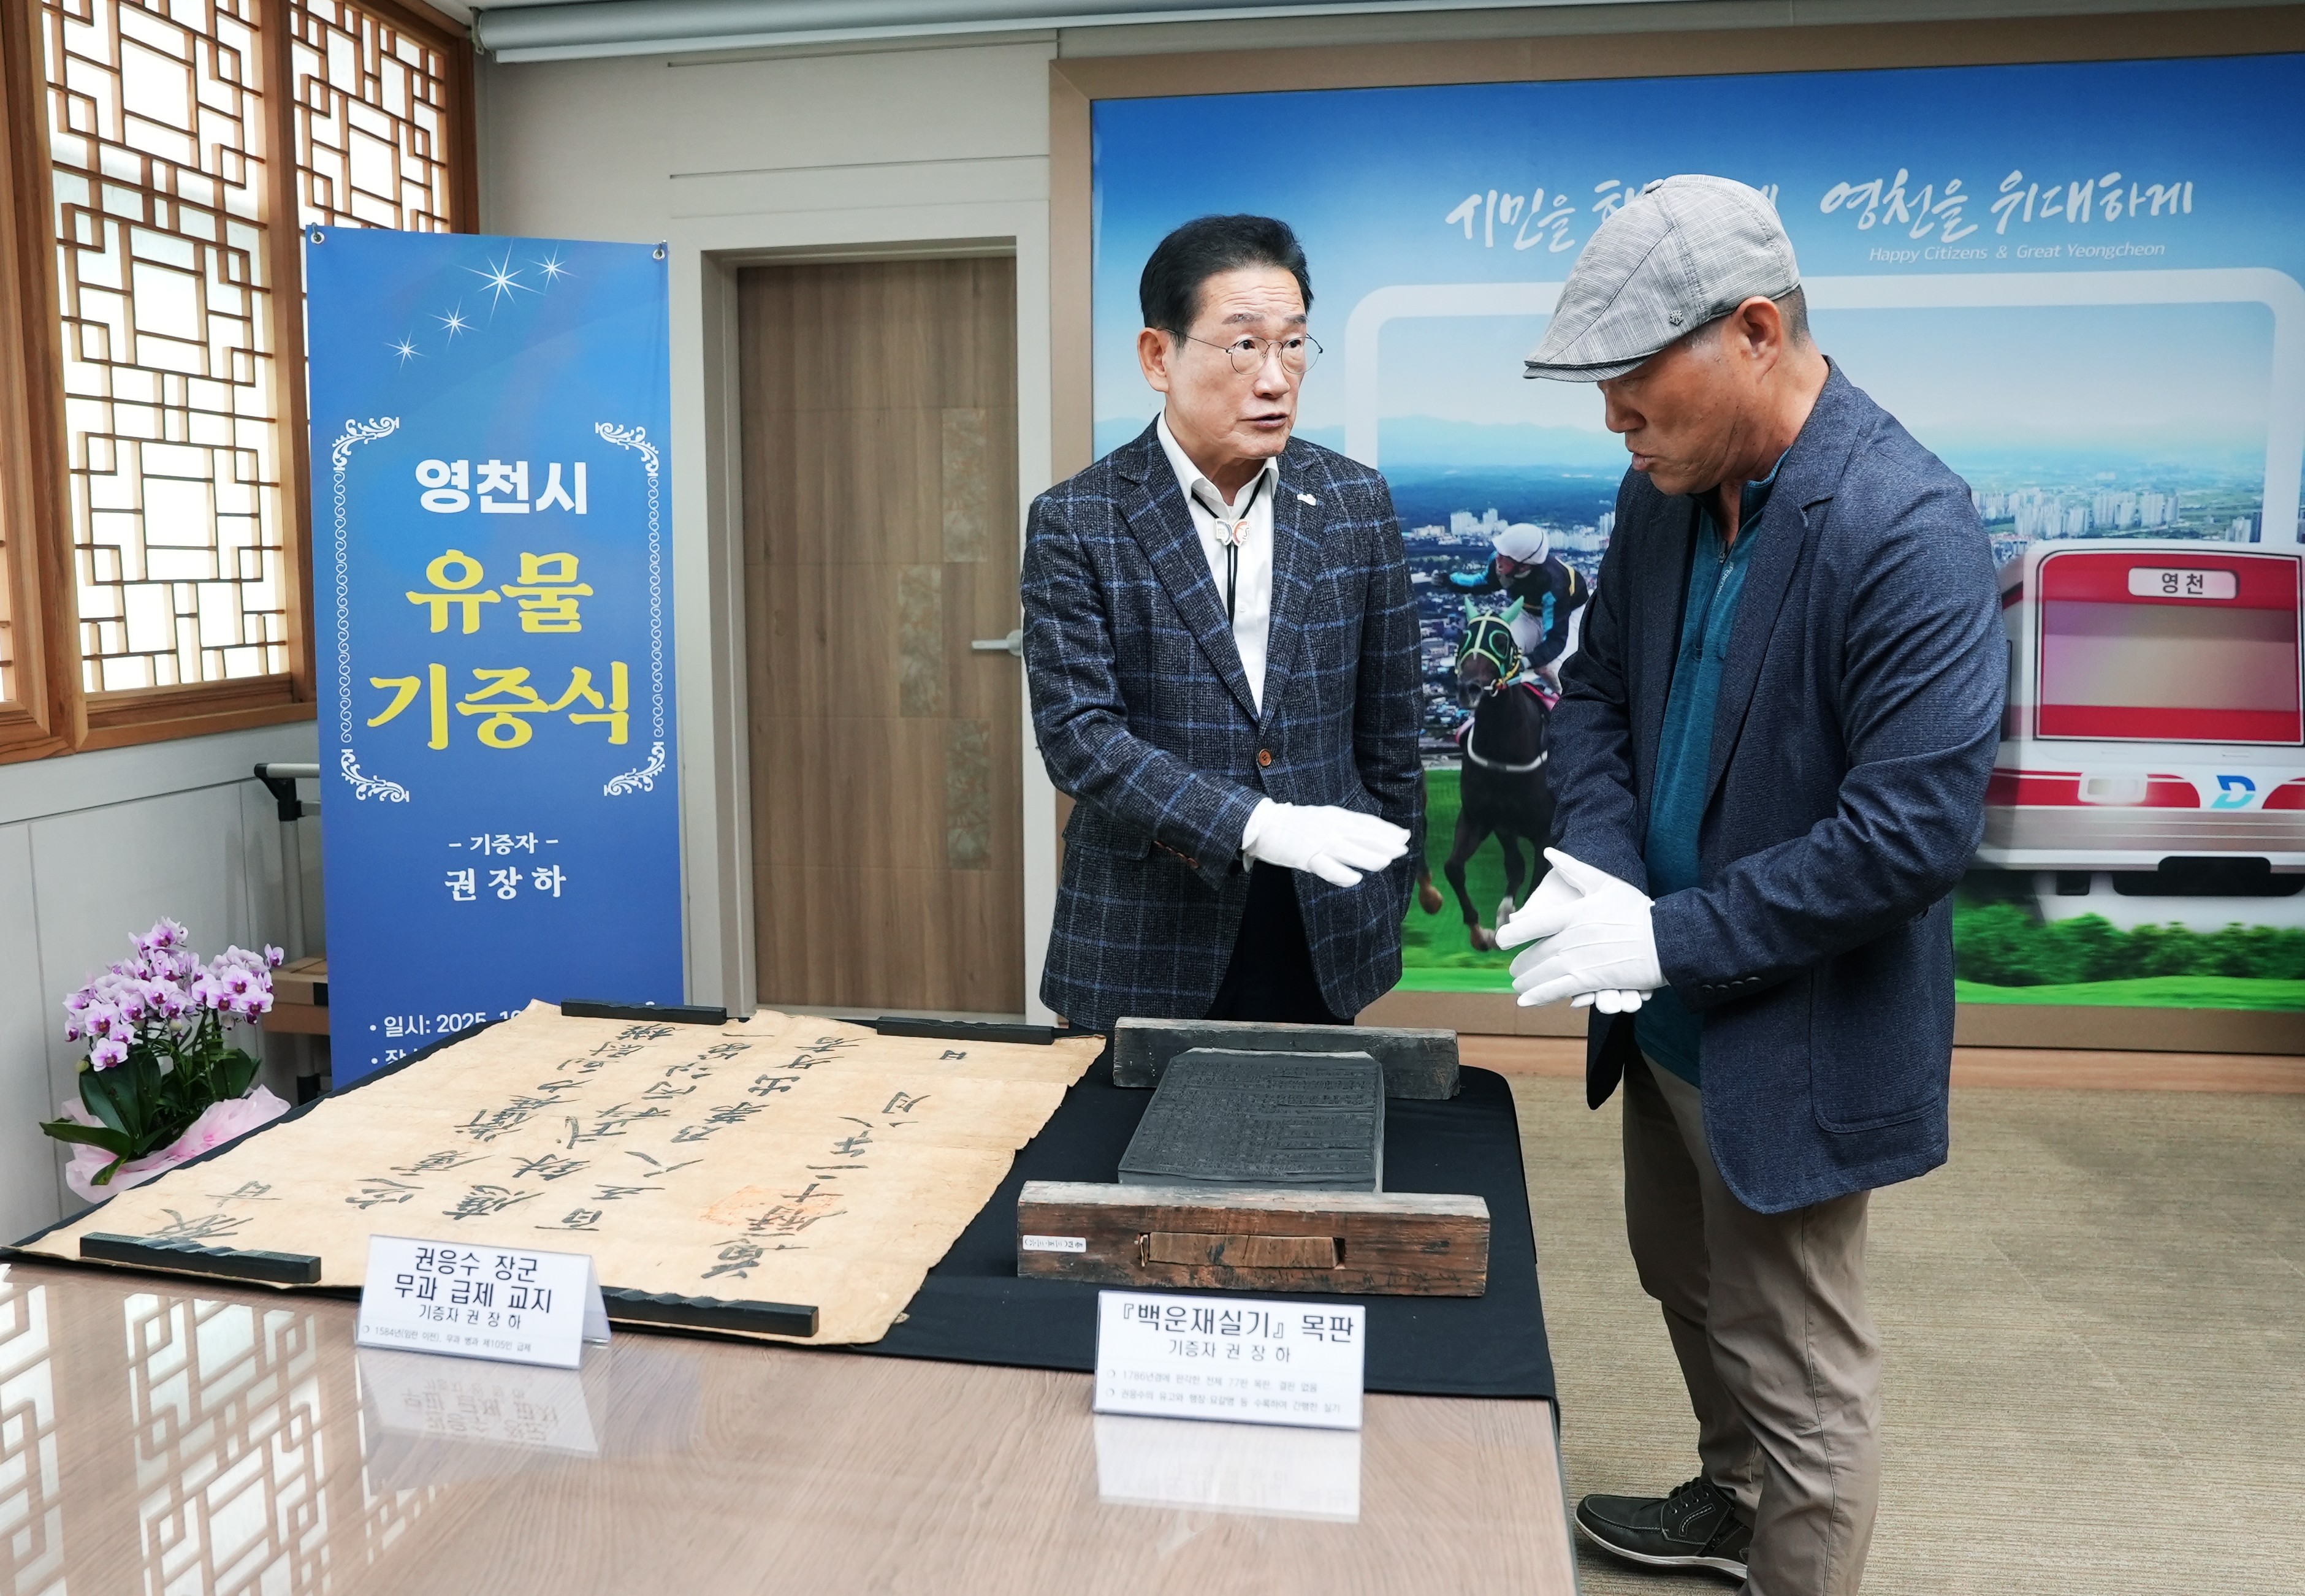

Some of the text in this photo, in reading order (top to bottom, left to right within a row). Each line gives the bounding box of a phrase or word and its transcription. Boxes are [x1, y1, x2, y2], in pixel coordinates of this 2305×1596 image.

[1445, 187, 1575, 253] 시민을
[1820, 168, 1978, 243] 영천을
[1991, 170, 2193, 235] 위대하게
[1869, 241, 2165, 264] Happy Citizens & Great Yeongcheon
[416, 459, 587, 515] 영천시
[405, 549, 593, 634] 유물
[367, 661, 629, 750] 기증식
[384, 1014, 431, 1038] 일시:
[415, 1247, 537, 1283] 권응수 장군
[394, 1274, 552, 1313] 무과 급제 교지
[419, 1304, 460, 1323] 기증자
[1123, 1303, 1354, 1343] 『백운재실기』 목판
[1170, 1340, 1216, 1358] 기증자
